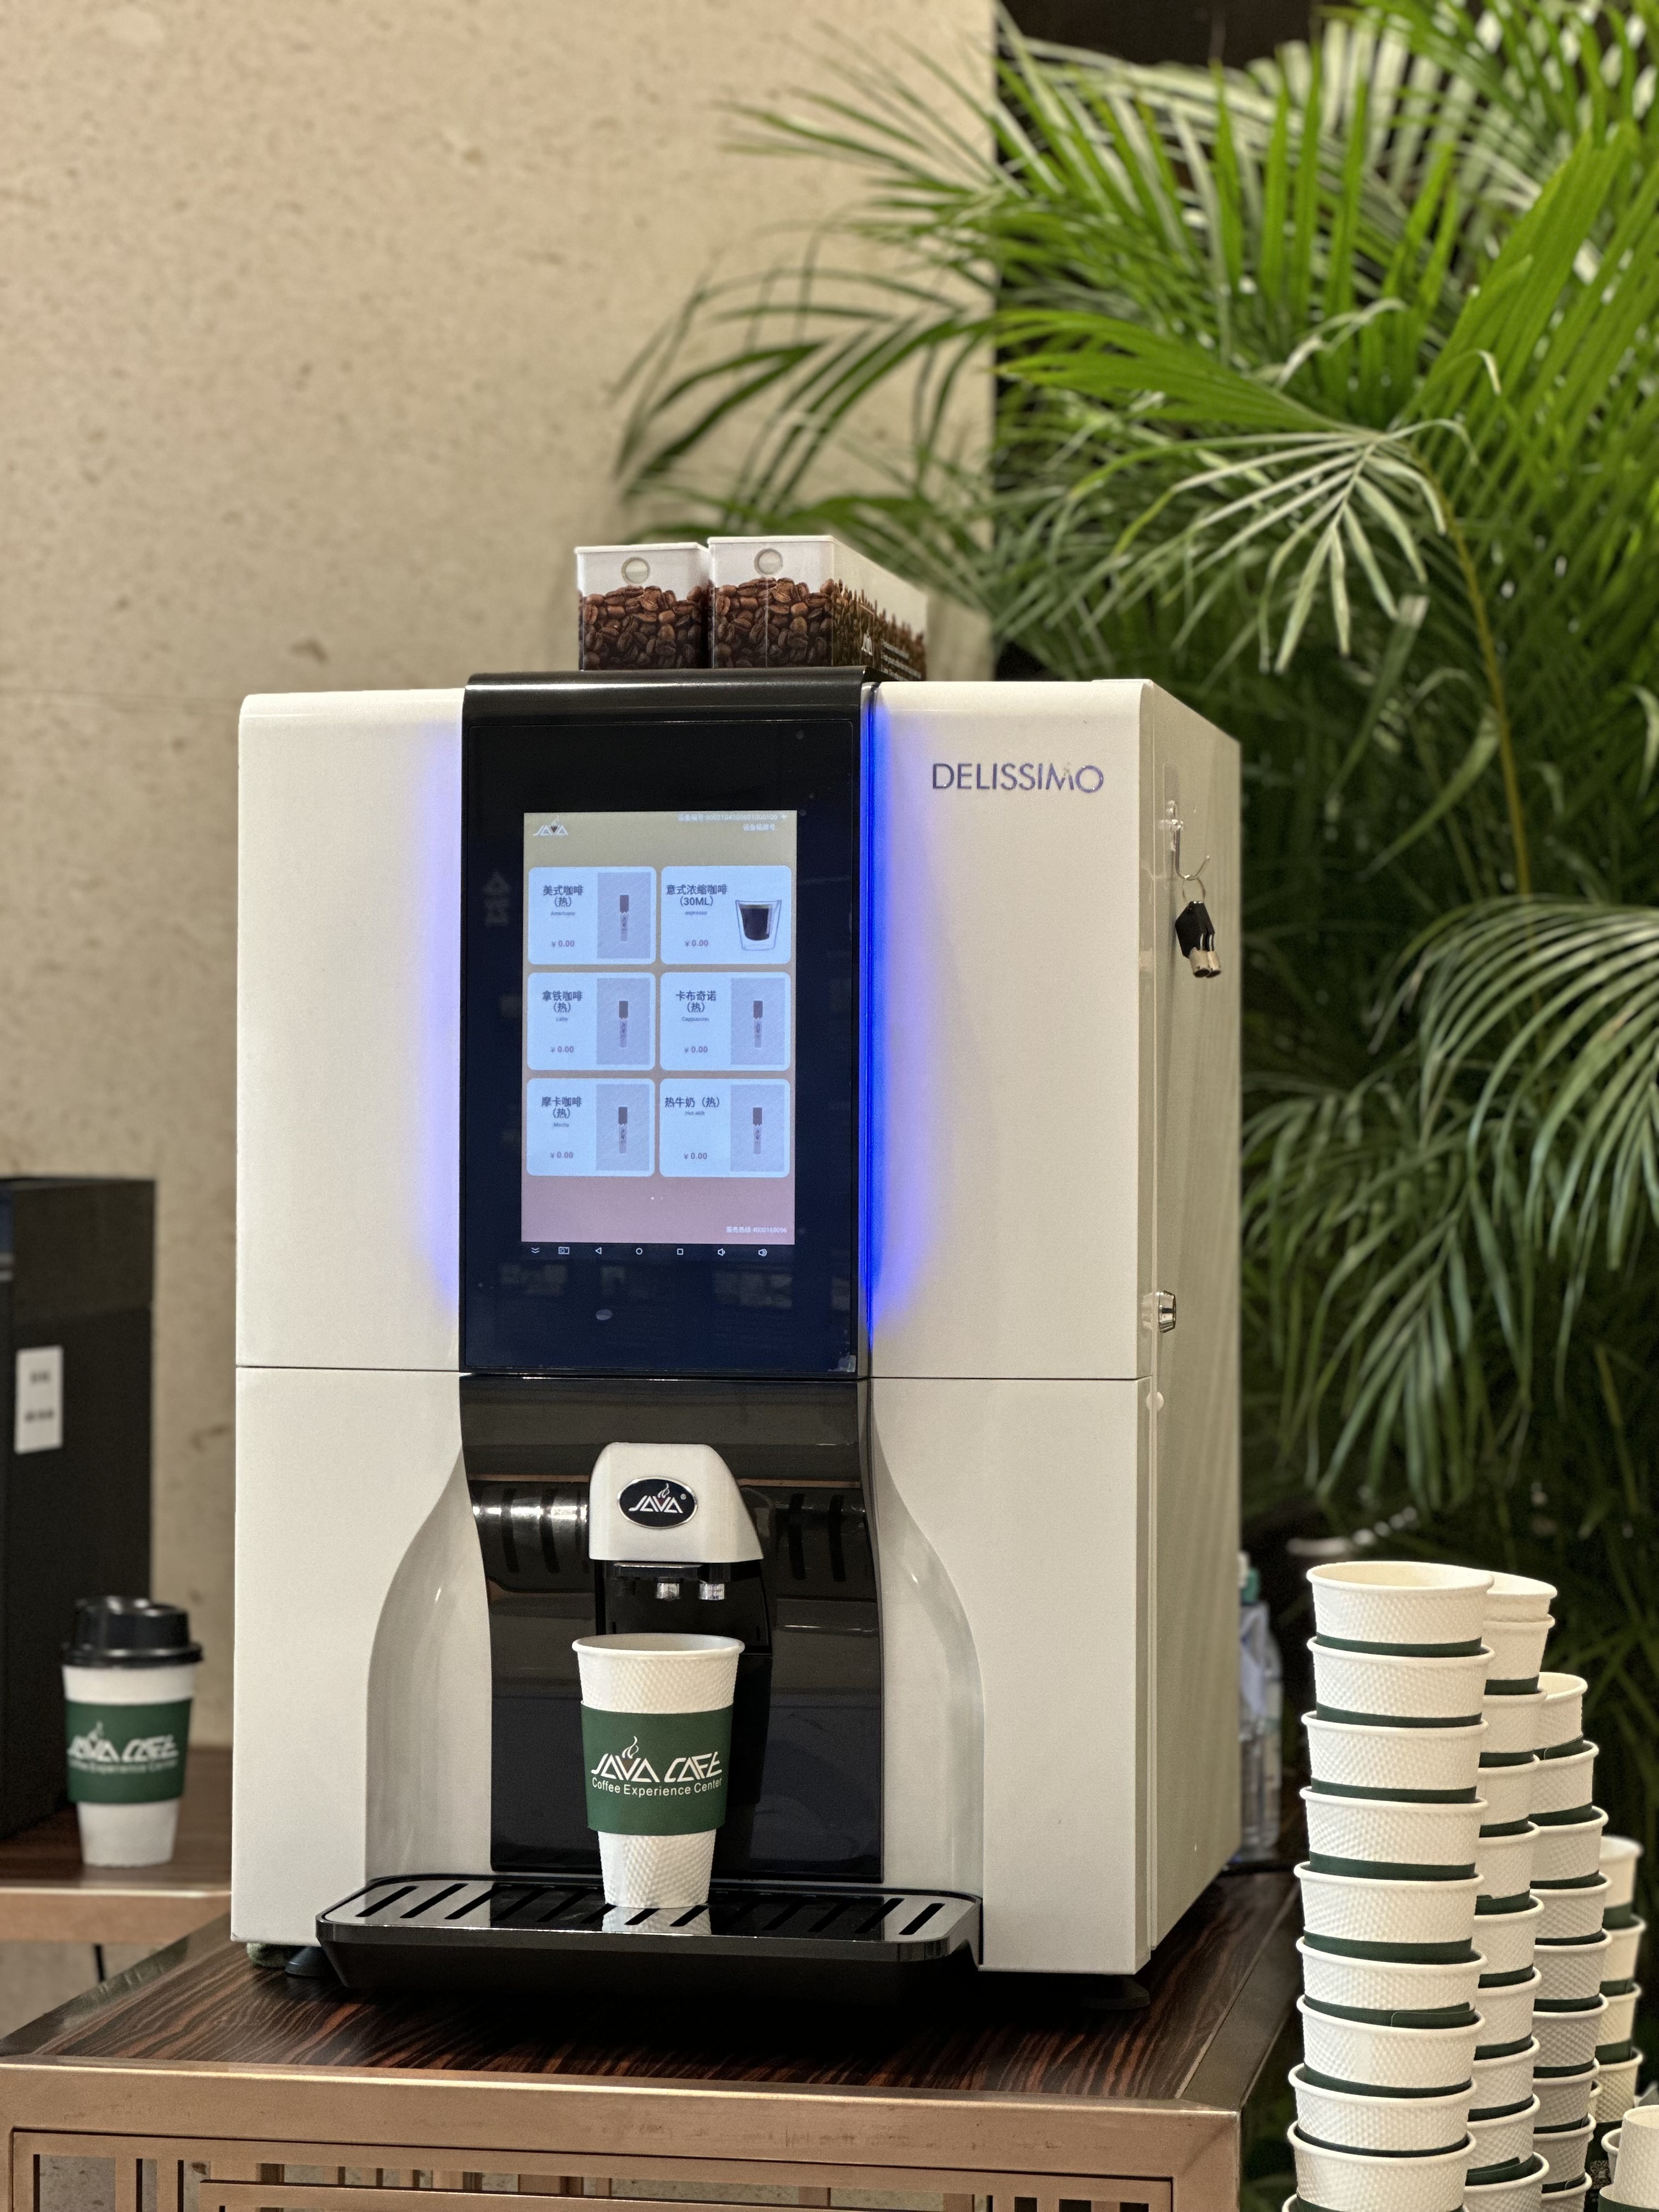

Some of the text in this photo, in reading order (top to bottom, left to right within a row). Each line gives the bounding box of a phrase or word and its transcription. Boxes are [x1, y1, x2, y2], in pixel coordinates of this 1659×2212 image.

[933, 763, 1104, 793] DELISSIMO
[543, 885, 584, 896] 美式咖啡
[666, 884, 727, 895] 意式浓缩咖啡
[554, 896, 572, 907] (热)
[680, 896, 713, 906] (30ML)
[542, 990, 583, 1001] 拿铁咖啡
[675, 990, 716, 1001] 卡布奇诺
[554, 1002, 571, 1013] (热)
[687, 1002, 705, 1013] (热)
[541, 1096, 582, 1107] 摩卡咖啡
[552, 1108, 571, 1119] (热)
[629, 1495, 683, 1513] JAVA
[591, 1753, 660, 1782] JAVA
[592, 1777, 722, 1798] Coffee Experience Center
